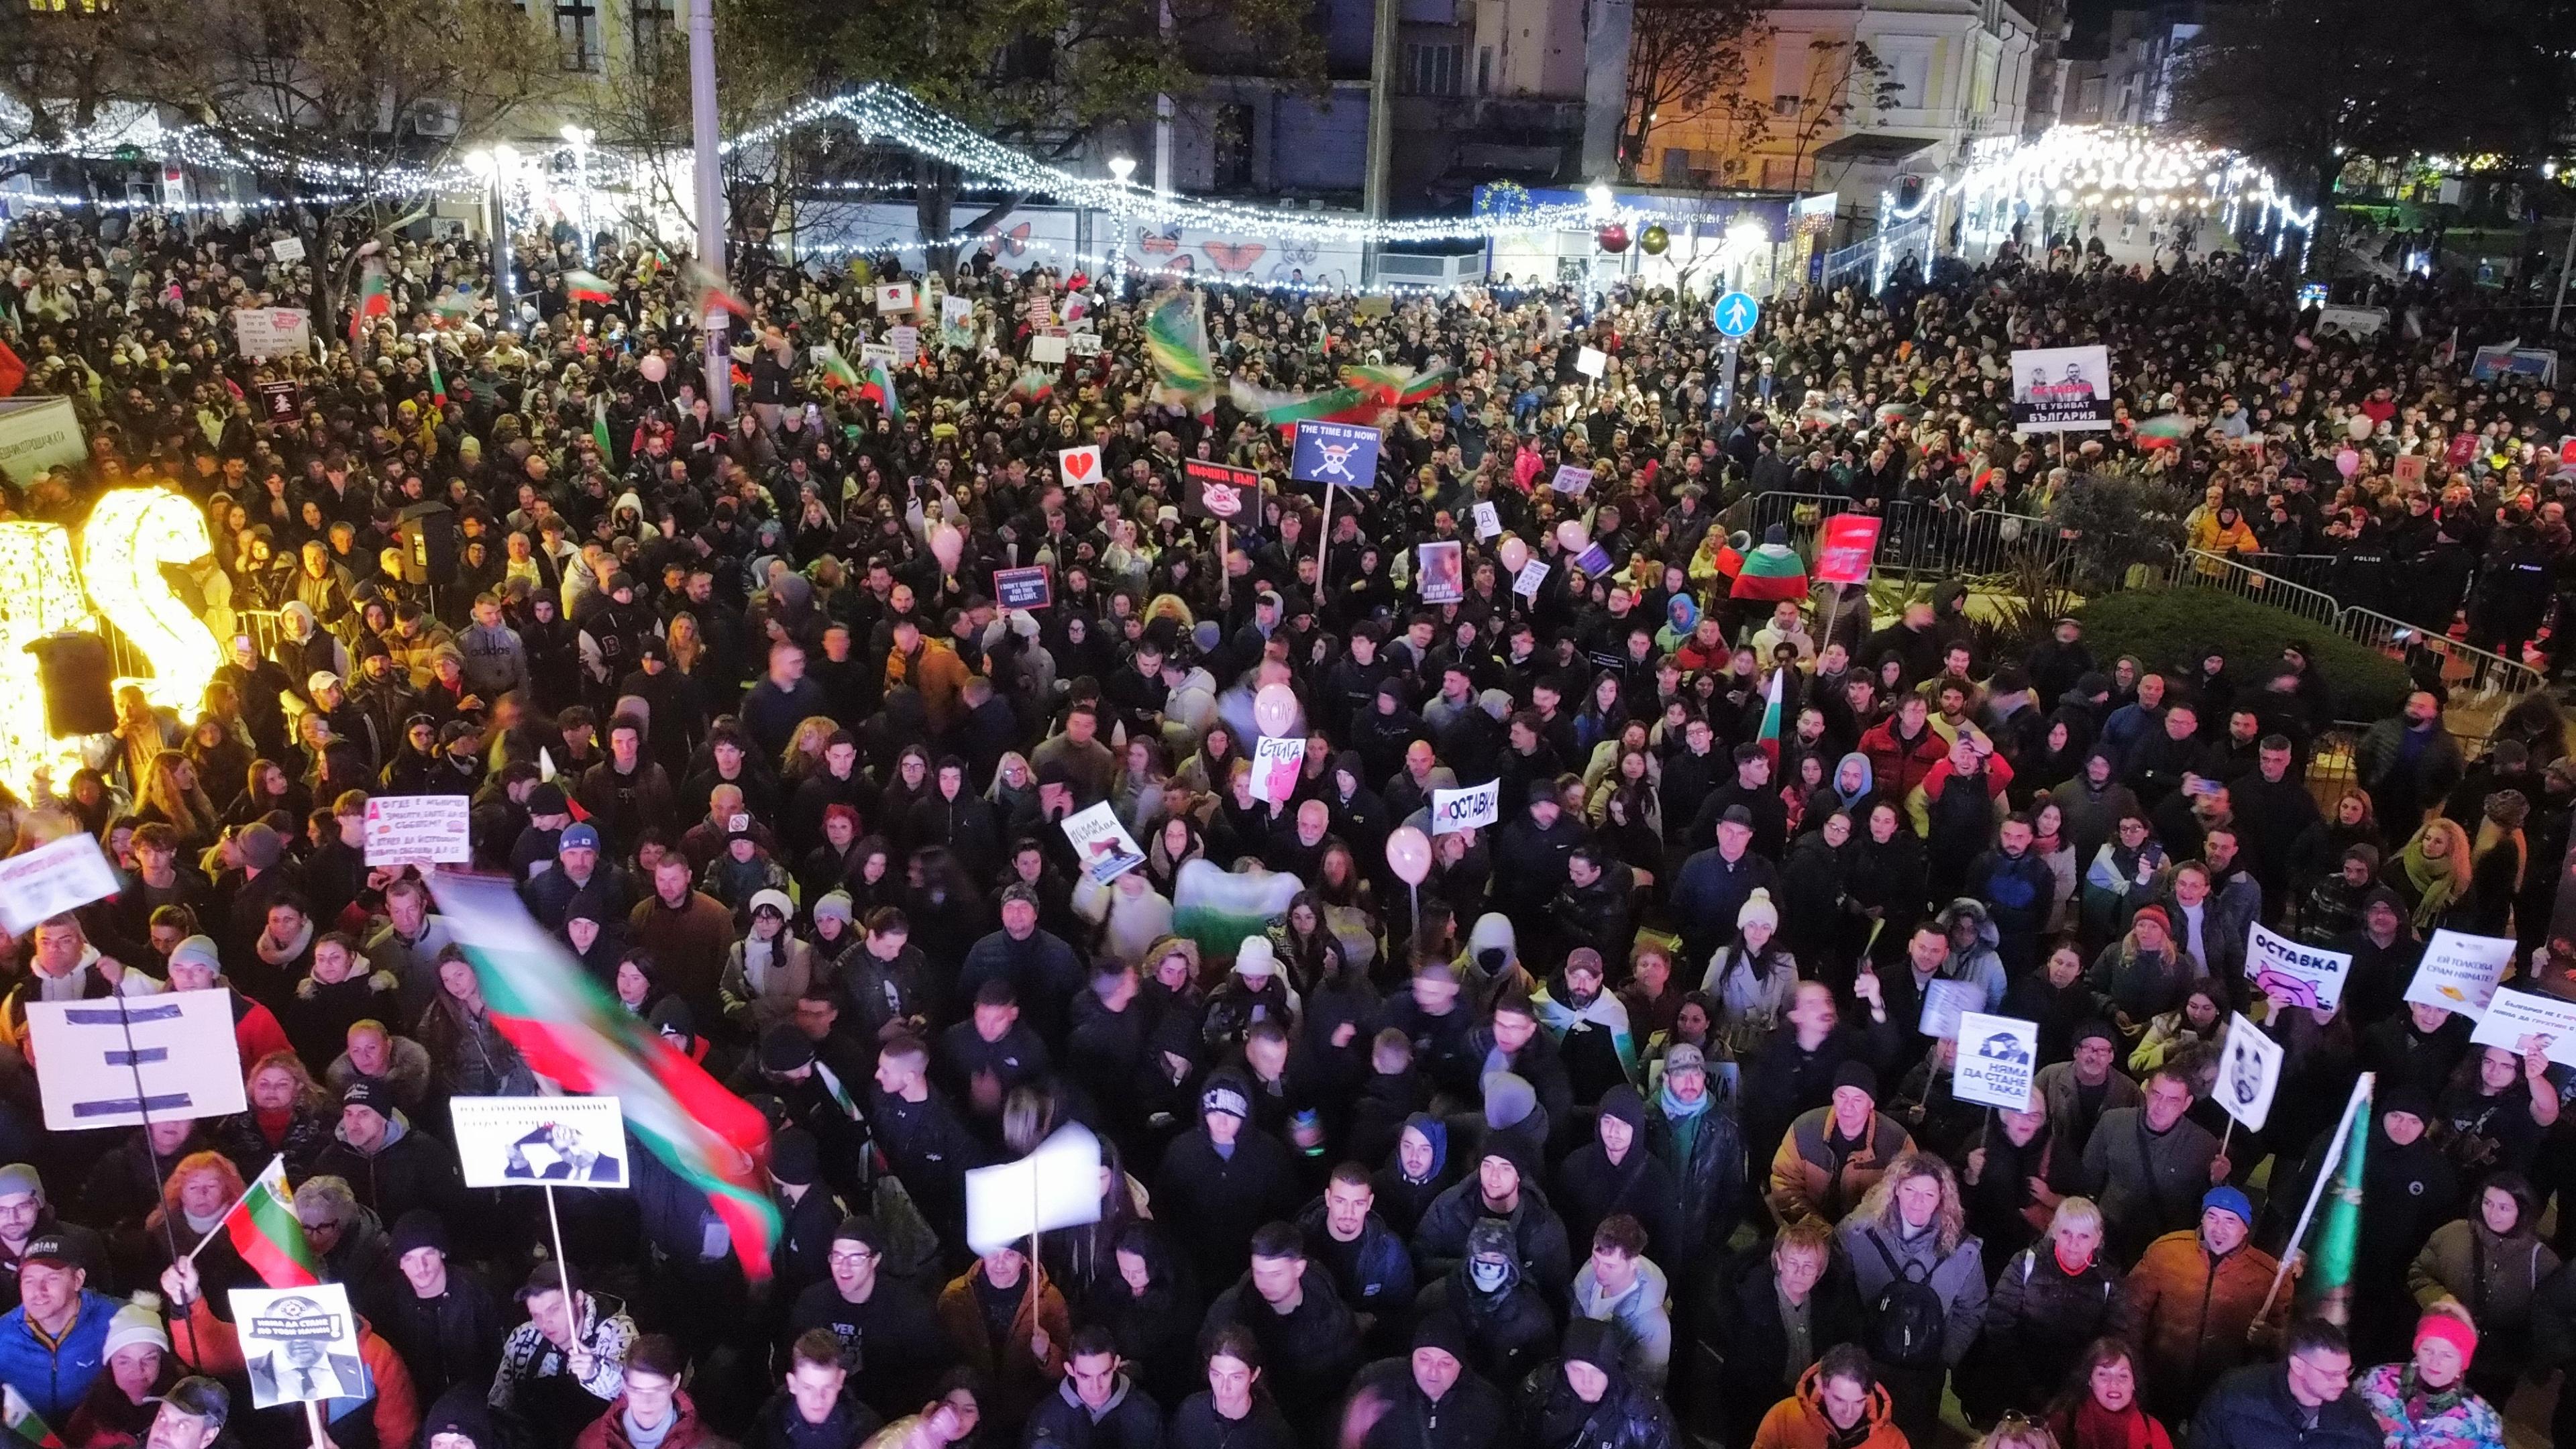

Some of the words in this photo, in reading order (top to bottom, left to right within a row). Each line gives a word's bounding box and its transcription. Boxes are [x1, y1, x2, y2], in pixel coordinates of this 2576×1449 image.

[2031, 383, 2093, 394] ОСТАВКА
[2050, 401, 2090, 410] УБИВАТ
[2029, 411, 2096, 422] БЪЛГАРИЯ
[1301, 425, 1318, 433] THE
[1320, 427, 1341, 436] TIME
[1343, 429, 1352, 437] IS
[1354, 431, 1377, 441] NOW!
[471, 643, 511, 657] adidas
[1449, 791, 1495, 820] ОСТАВКА
[2256, 934, 2338, 972] ОСТАВКА
[2436, 955, 2450, 965] ЕЙ
[2452, 959, 2493, 971] ТОЛКОВА
[2426, 965, 2453, 977] СРАМ
[2454, 971, 2493, 983] НЯМАТЕ!
[1963, 1067, 1982, 1079] ДА
[1984, 1072, 2027, 1087] СТАНЕ
[1988, 1063, 2028, 1077] НЯМА
[1987, 1082, 2027, 1097] ТАКА!
